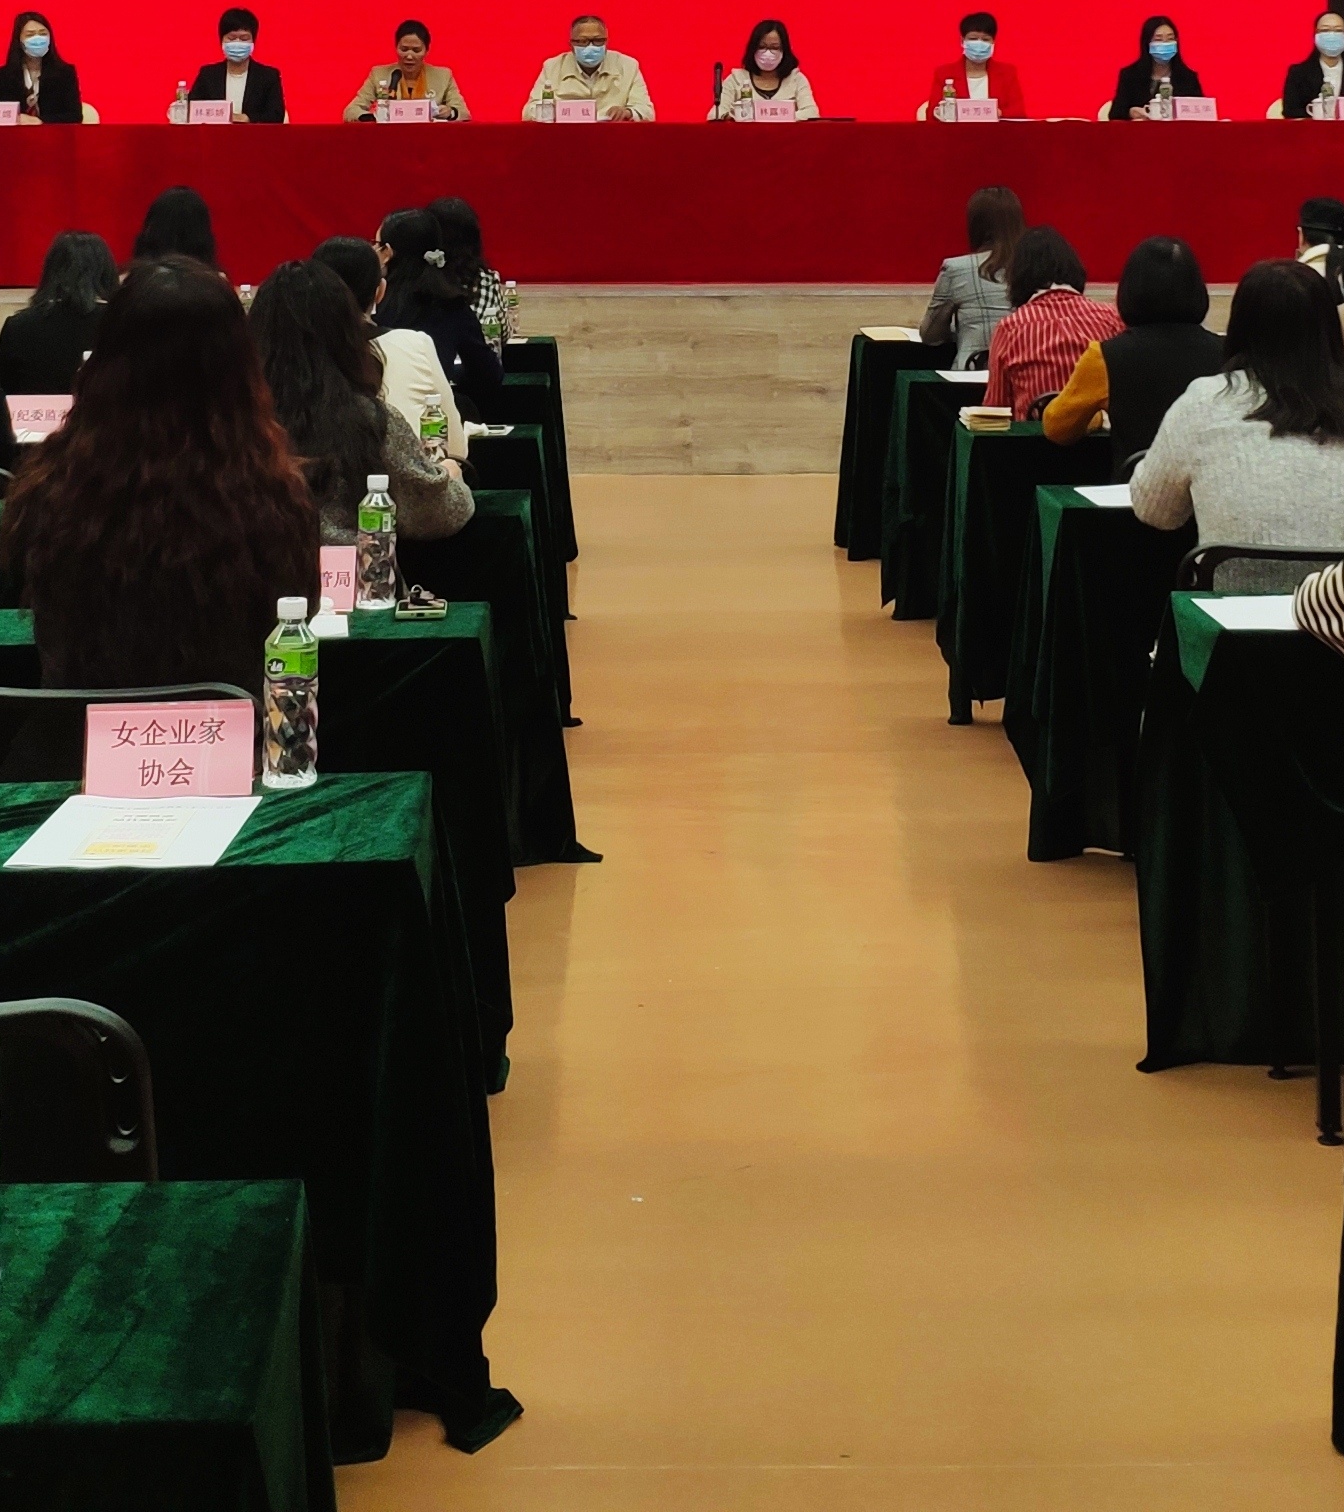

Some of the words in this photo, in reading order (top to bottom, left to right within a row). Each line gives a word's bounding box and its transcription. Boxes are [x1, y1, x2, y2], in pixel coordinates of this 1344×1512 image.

[111, 717, 226, 749] 女企业家
[138, 758, 195, 787] 协会
